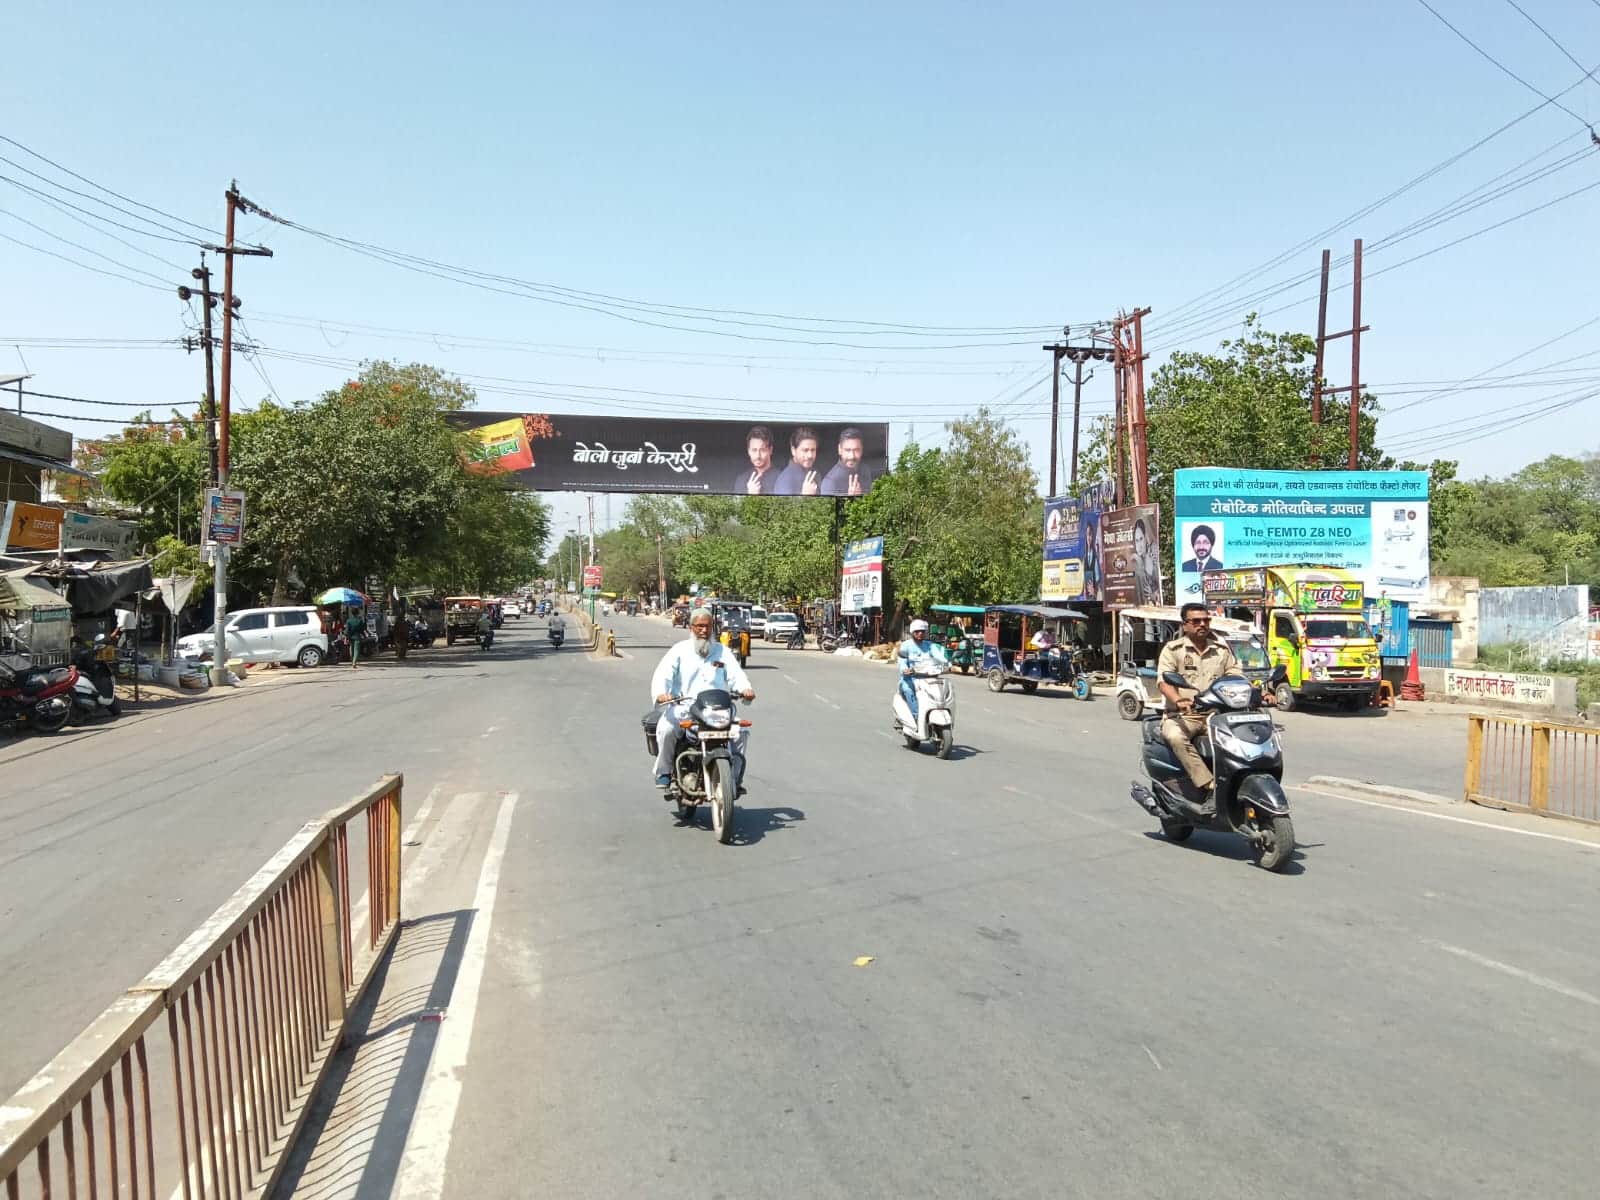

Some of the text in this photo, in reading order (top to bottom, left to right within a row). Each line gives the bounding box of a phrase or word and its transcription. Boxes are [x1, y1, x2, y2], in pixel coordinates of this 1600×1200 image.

[573, 441, 611, 463] बोलो
[644, 441, 699, 473] केसरी
[1190, 480, 1210, 490] उत्तर
[1212, 478, 1231, 490] प्रदेश
[1233, 478, 1244, 489] की
[1346, 480, 1377, 490] रोबोटिक
[1210, 499, 1366, 515] रोबोटिक मोतियाबिन्द उपचार
[1243, 527, 1353, 538] The FEMTO Z8 NEO
